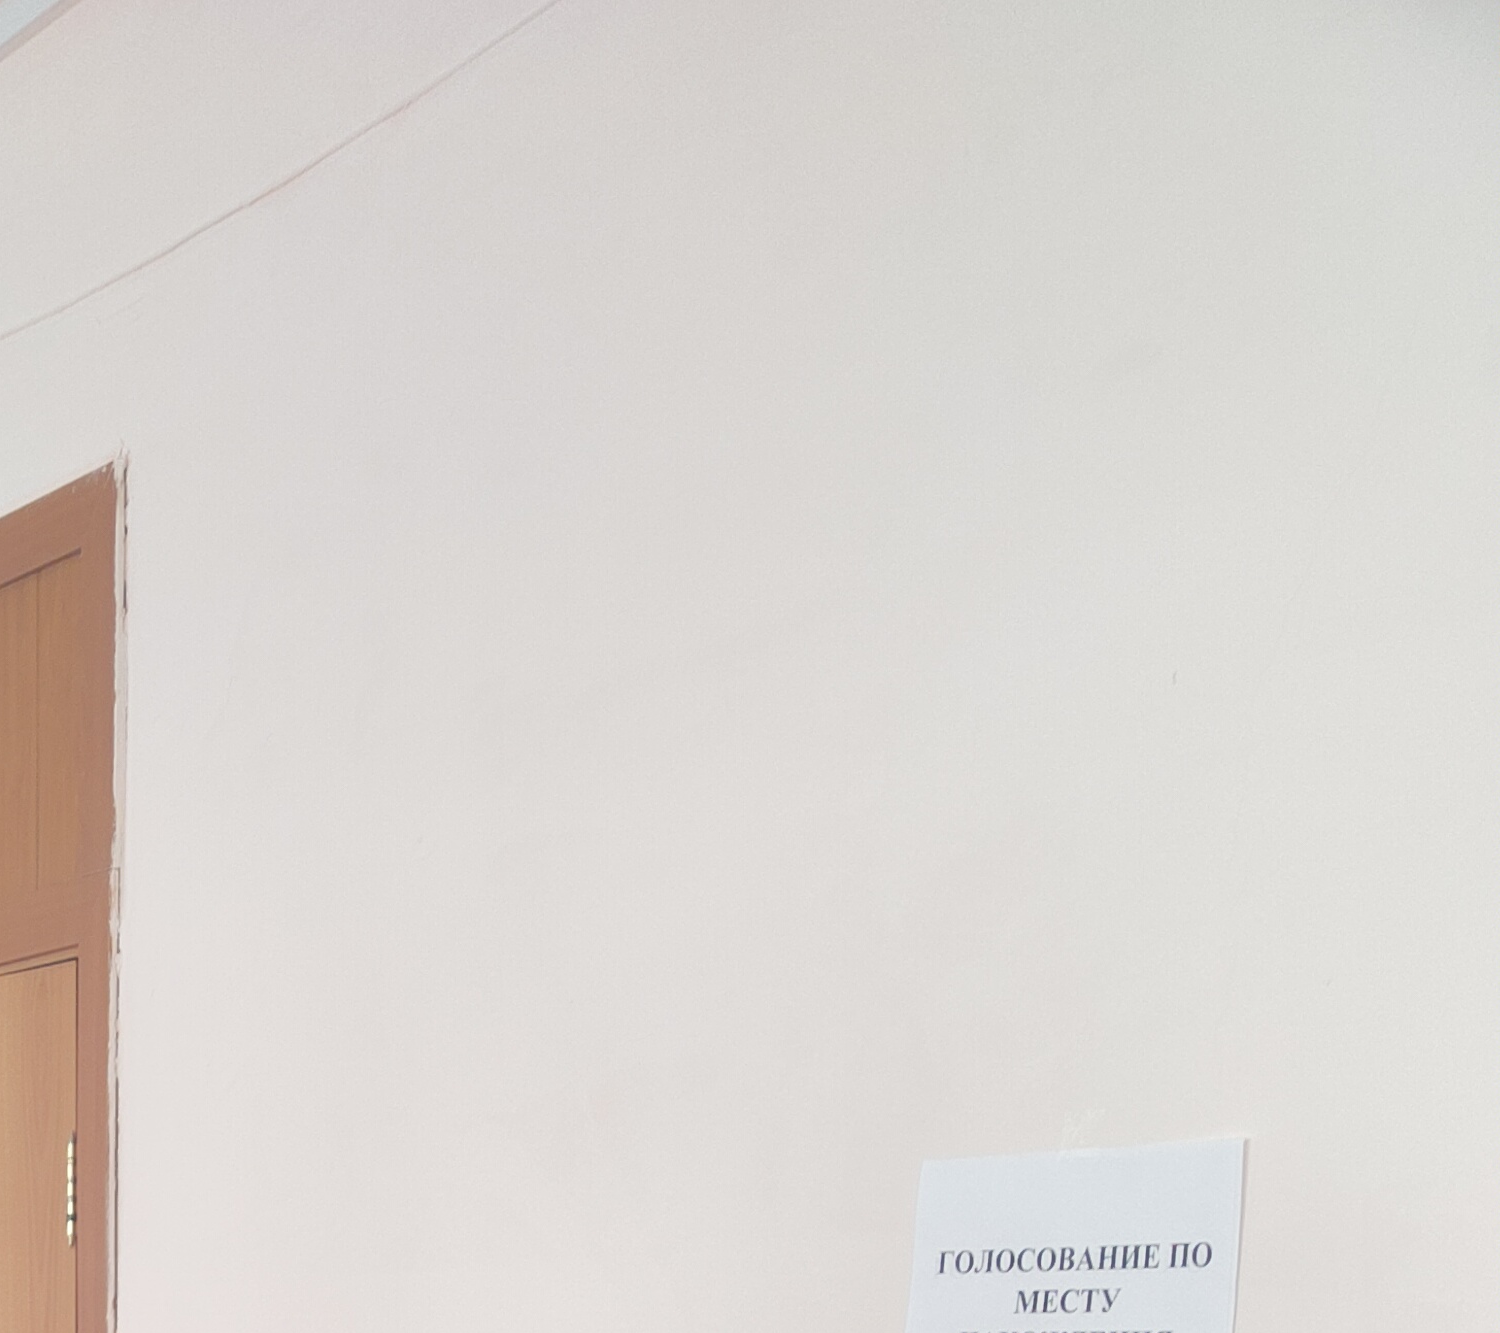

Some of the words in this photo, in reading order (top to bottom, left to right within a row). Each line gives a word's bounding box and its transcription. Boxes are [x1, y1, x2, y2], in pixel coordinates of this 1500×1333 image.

[936, 1242, 1161, 1275] ГОЛОСОВАНИЕ
[1168, 1241, 1213, 1269] ПО
[1014, 1288, 1122, 1315] МЕСТУ
